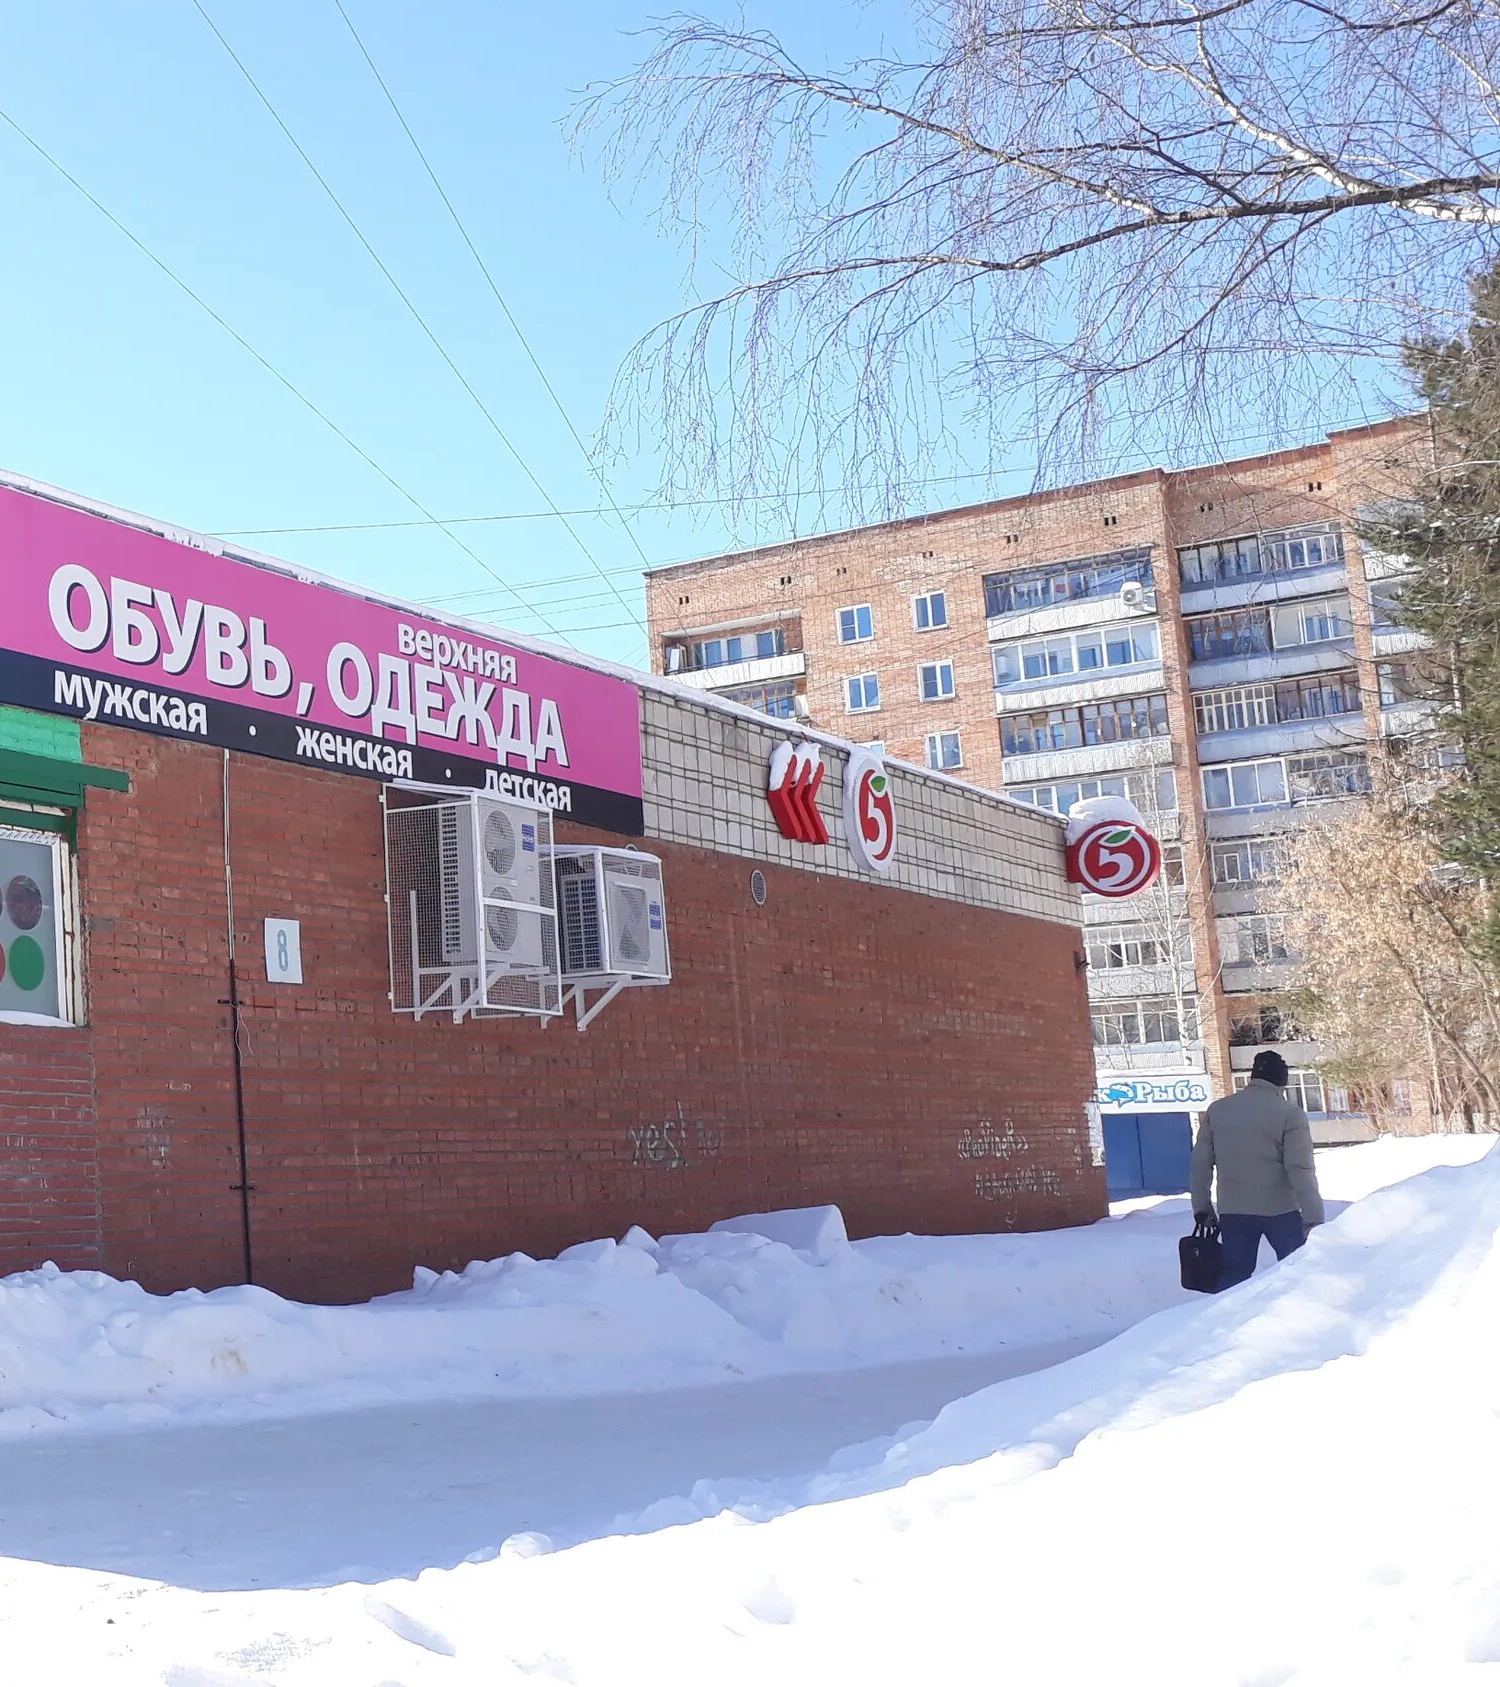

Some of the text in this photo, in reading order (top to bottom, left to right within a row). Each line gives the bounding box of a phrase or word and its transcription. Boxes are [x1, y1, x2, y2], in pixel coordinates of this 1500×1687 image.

[48, 563, 569, 772] ОБУВЬ, ОДЕЖДА
[397, 623, 517, 685] верхняя
[54, 670, 572, 813] мужская женская детская
[277, 929, 288, 971] 8
[1134, 1080, 1207, 1103] Рыба
